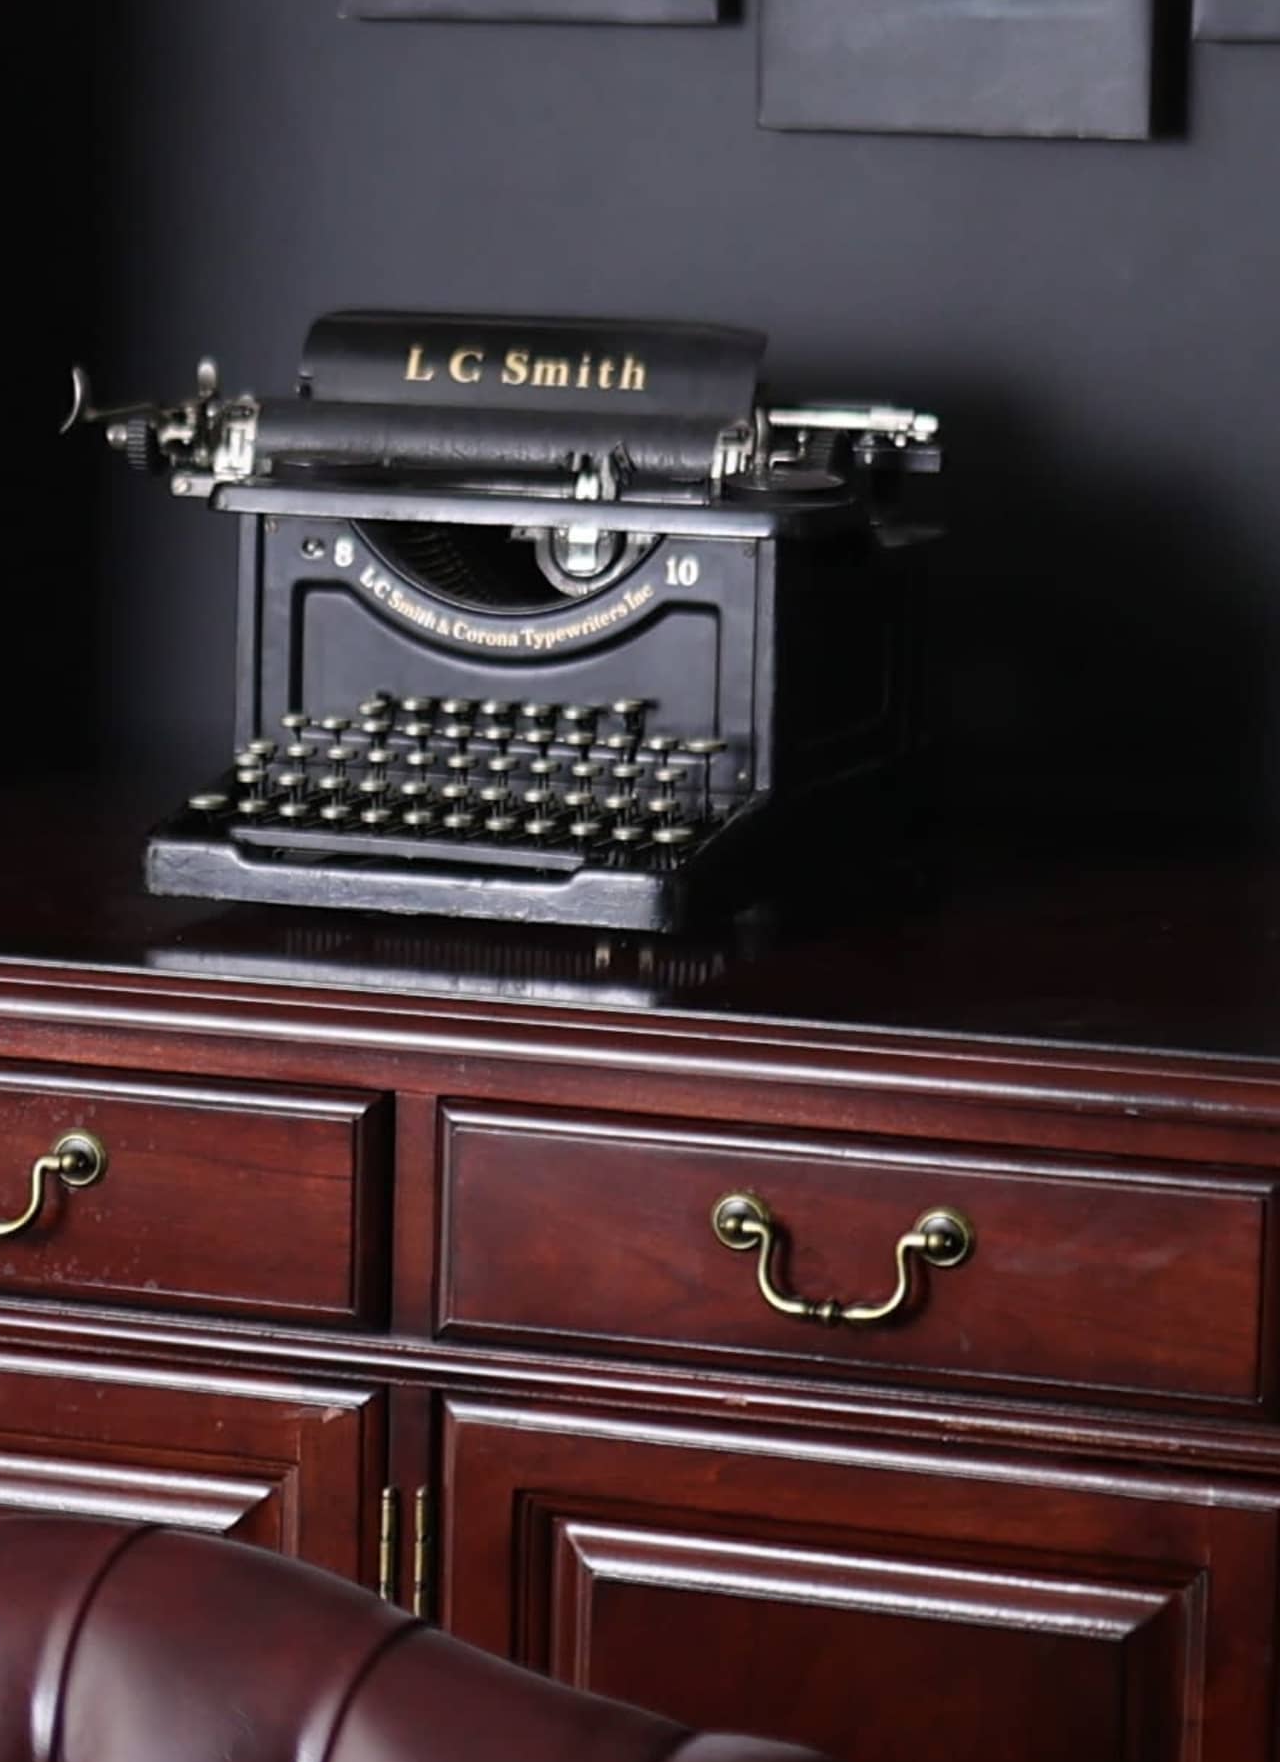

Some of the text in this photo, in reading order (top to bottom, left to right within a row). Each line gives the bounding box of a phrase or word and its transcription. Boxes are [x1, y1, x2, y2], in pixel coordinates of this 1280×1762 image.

[500, 346, 646, 391] Smith
[334, 540, 354, 568] 8
[665, 556, 699, 587] 10
[387, 589, 437, 631] Smith
[436, 618, 450, 636] &
[452, 619, 519, 648] Corona
[519, 601, 629, 650] Typewriters
[622, 583, 655, 611] Inc
